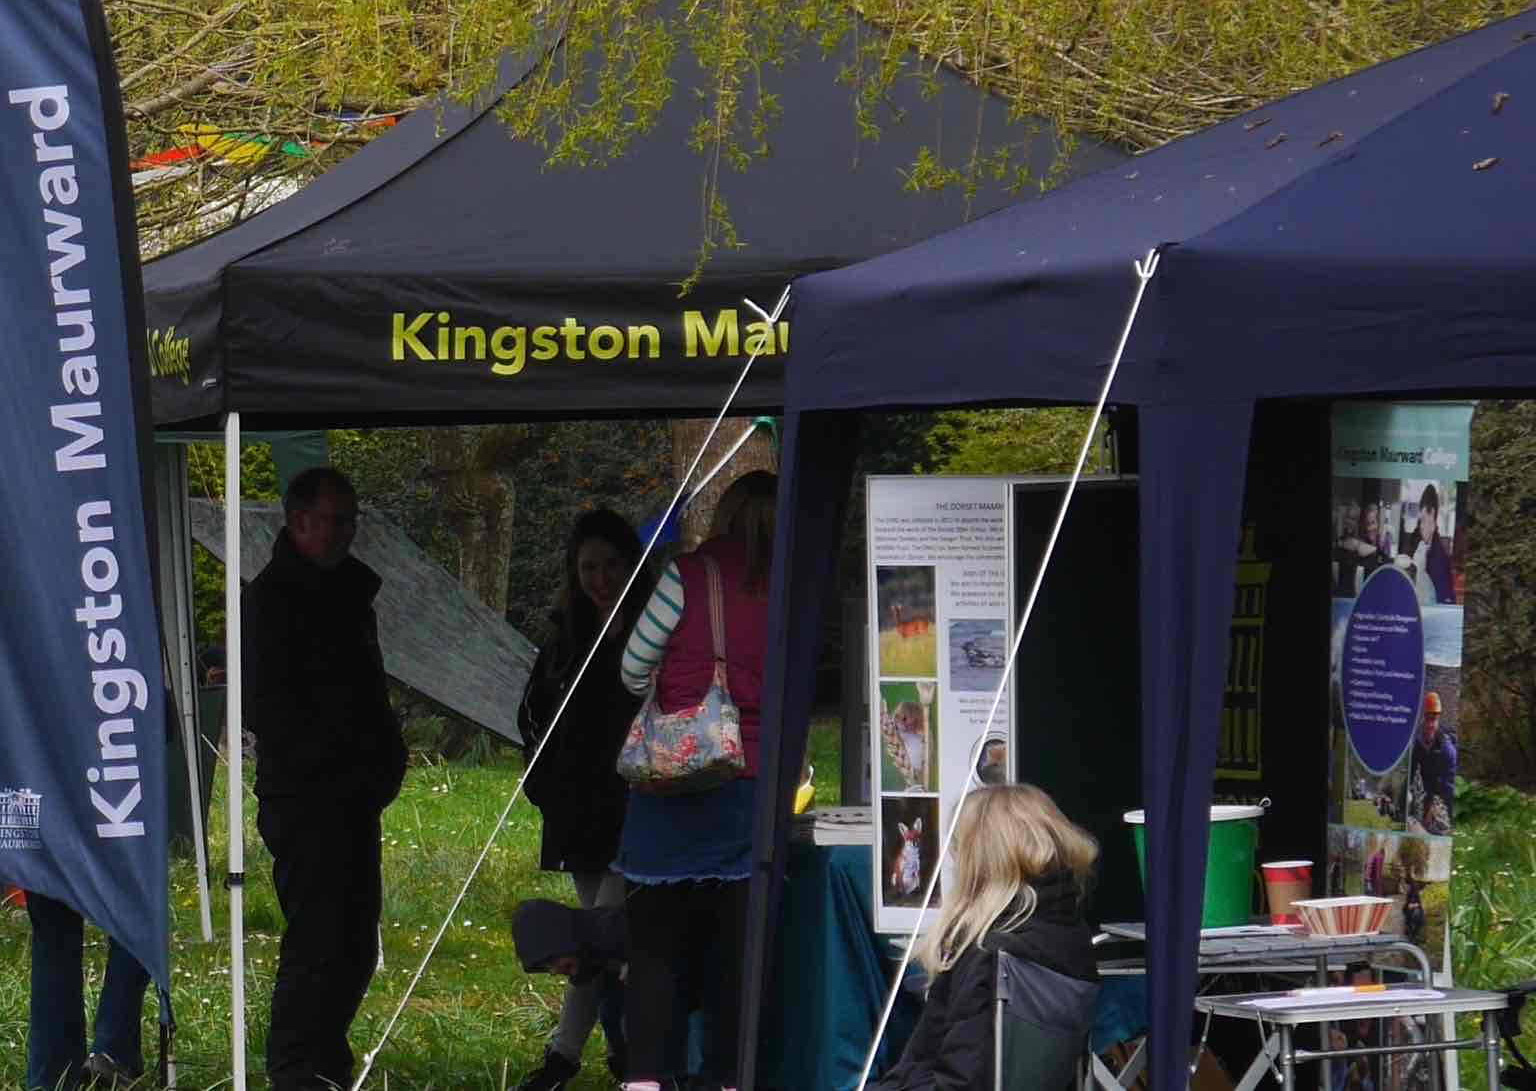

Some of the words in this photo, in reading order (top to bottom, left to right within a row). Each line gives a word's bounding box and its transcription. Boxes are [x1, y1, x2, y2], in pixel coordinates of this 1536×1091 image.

[8, 84, 107, 472] Maurward
[391, 311, 661, 376] Kingston
[75, 500, 148, 838] Kingston
